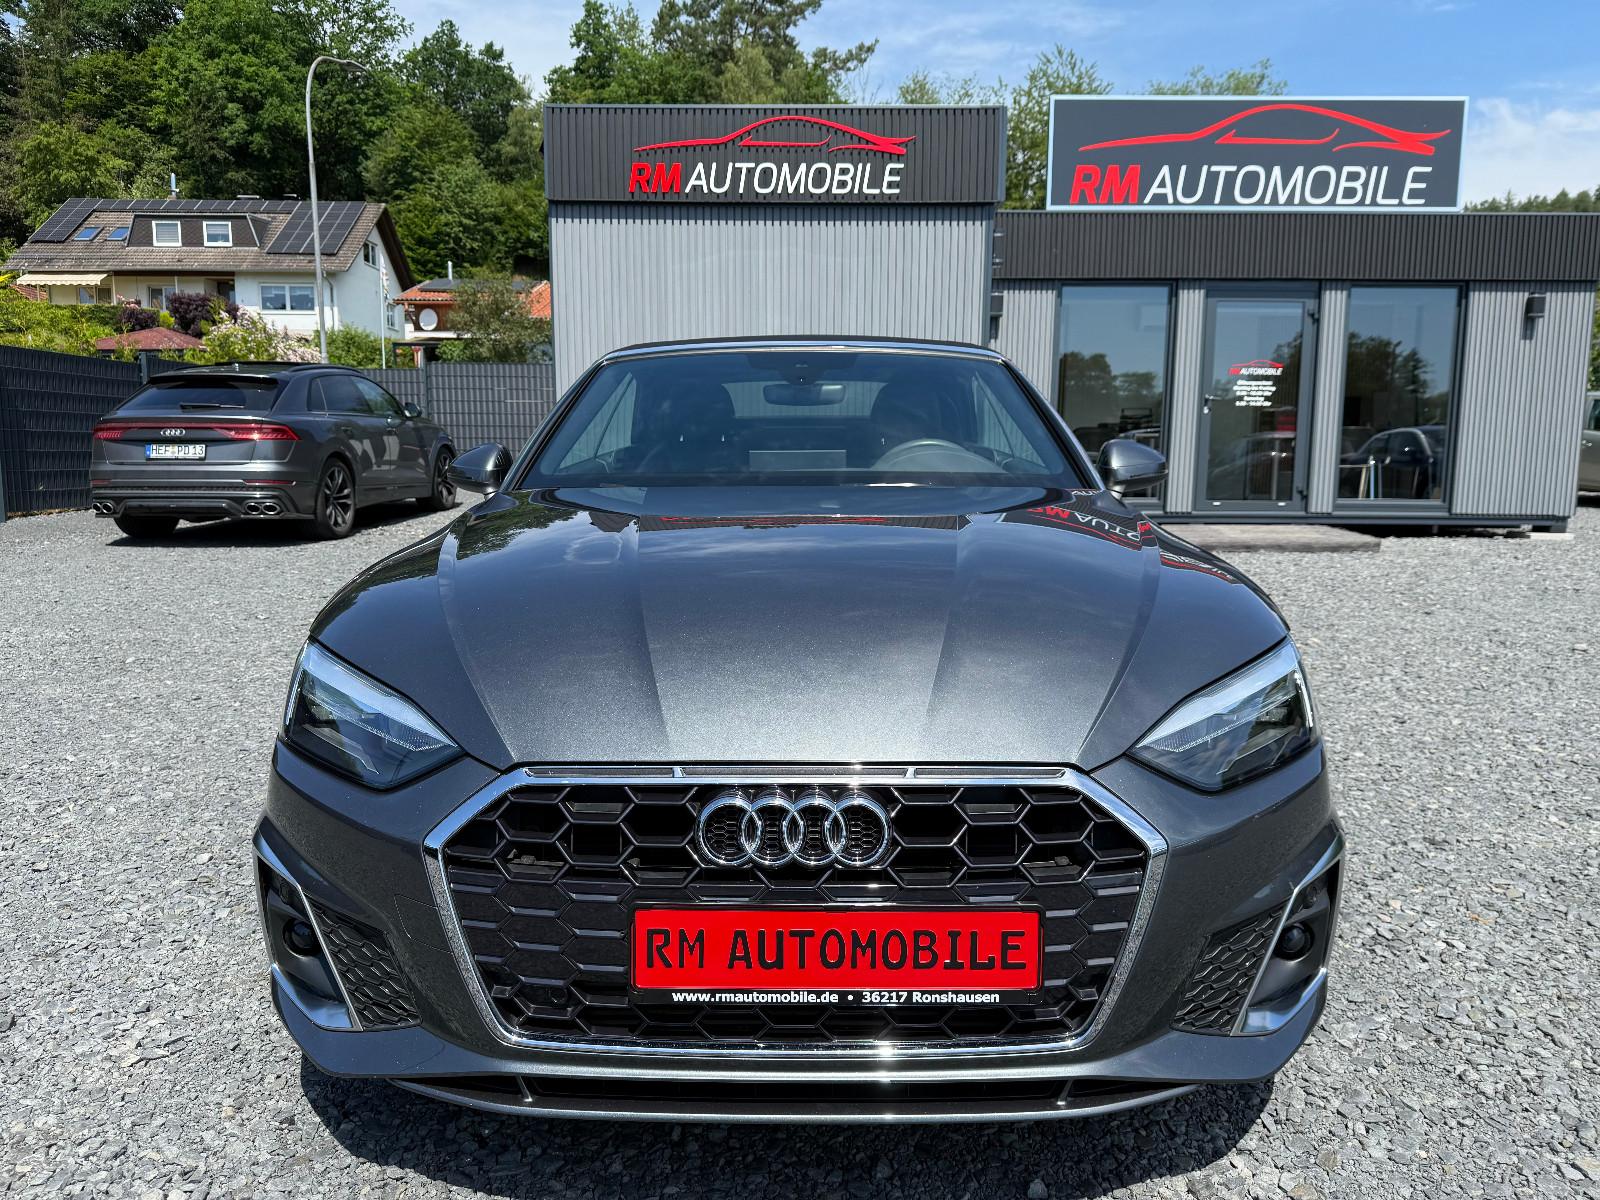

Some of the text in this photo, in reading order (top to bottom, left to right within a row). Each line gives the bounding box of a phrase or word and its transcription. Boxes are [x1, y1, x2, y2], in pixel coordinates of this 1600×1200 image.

[629, 162, 905, 194] RM AUTOMOBILE
[1070, 164, 1432, 205] RM AUTOMOBILE
[151, 445, 204, 455] HEF PD 13
[645, 928, 1027, 970] RM AUTOMOBILE
[671, 990, 1001, 1003] www.rmautomobile.de 36217 Ronshausen
